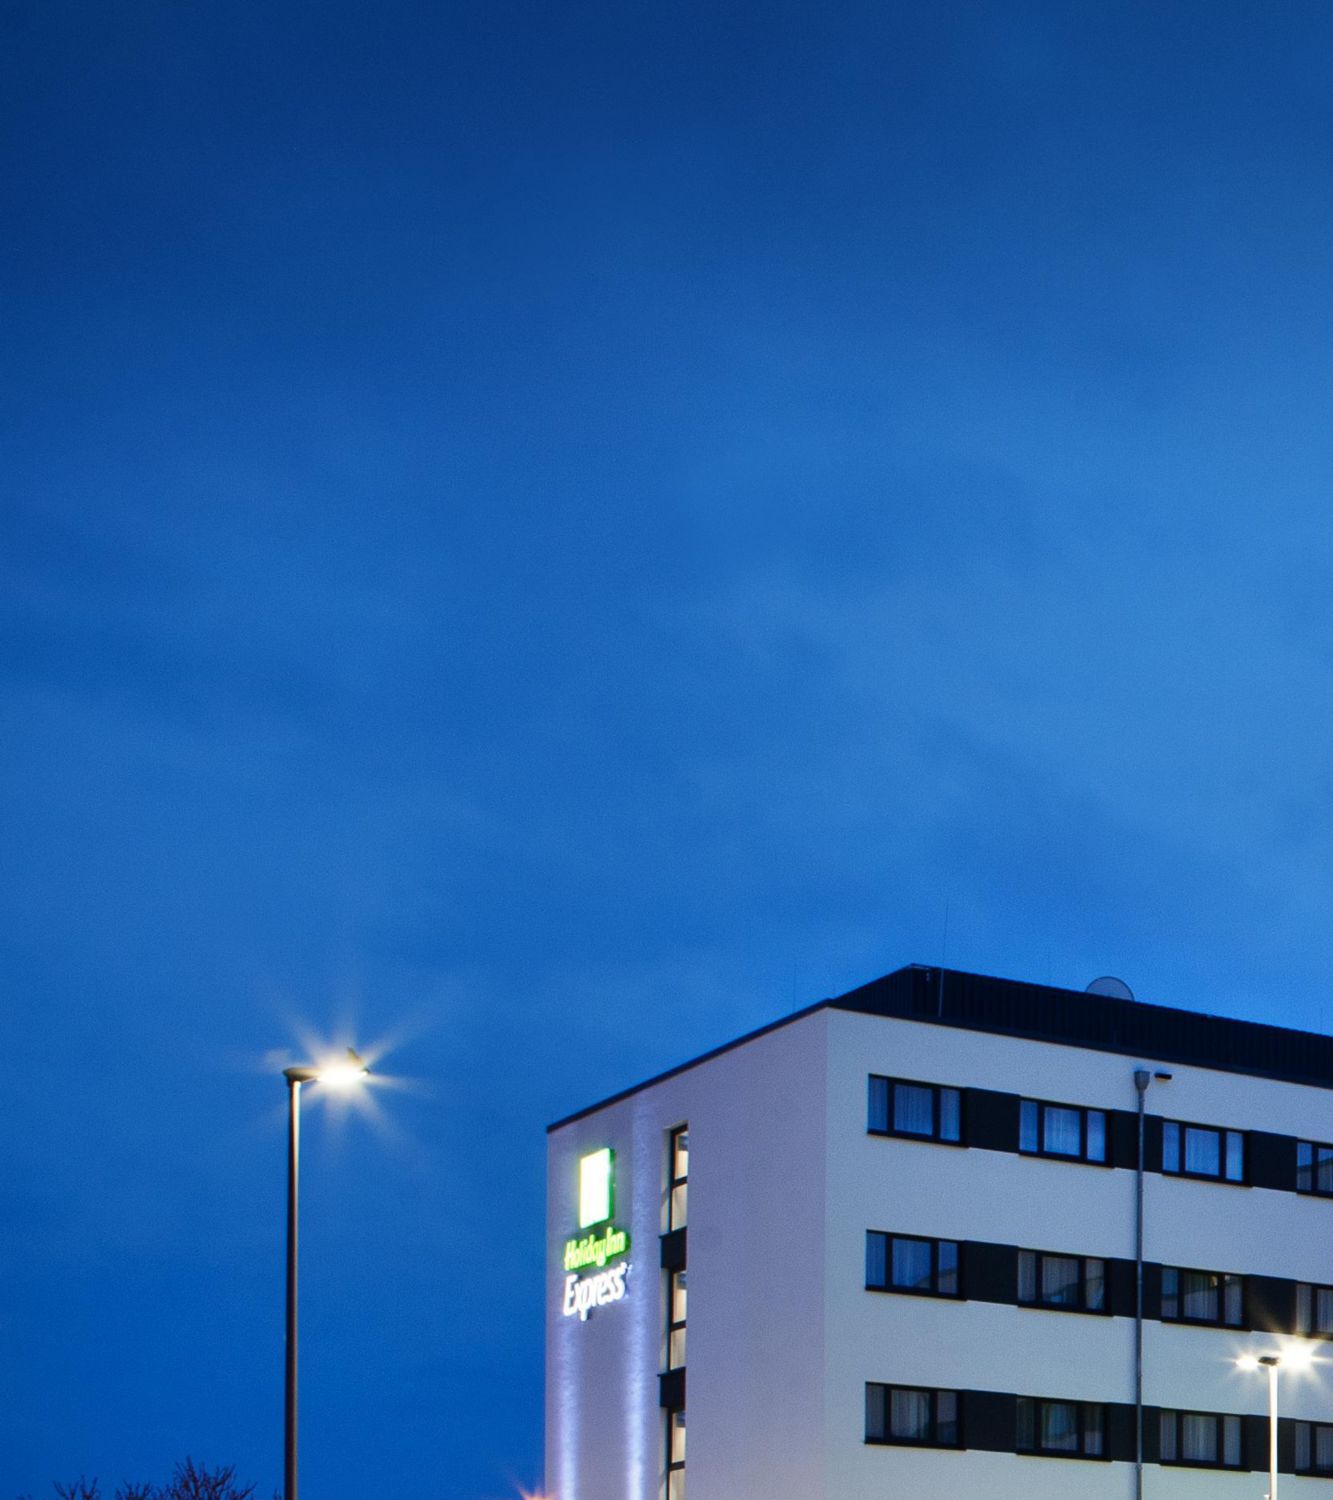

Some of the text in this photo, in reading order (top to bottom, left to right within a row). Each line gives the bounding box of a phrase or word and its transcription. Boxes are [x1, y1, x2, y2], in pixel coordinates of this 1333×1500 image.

[564, 1226, 626, 1271] Holiday Inn
[563, 1263, 627, 1321] Express
